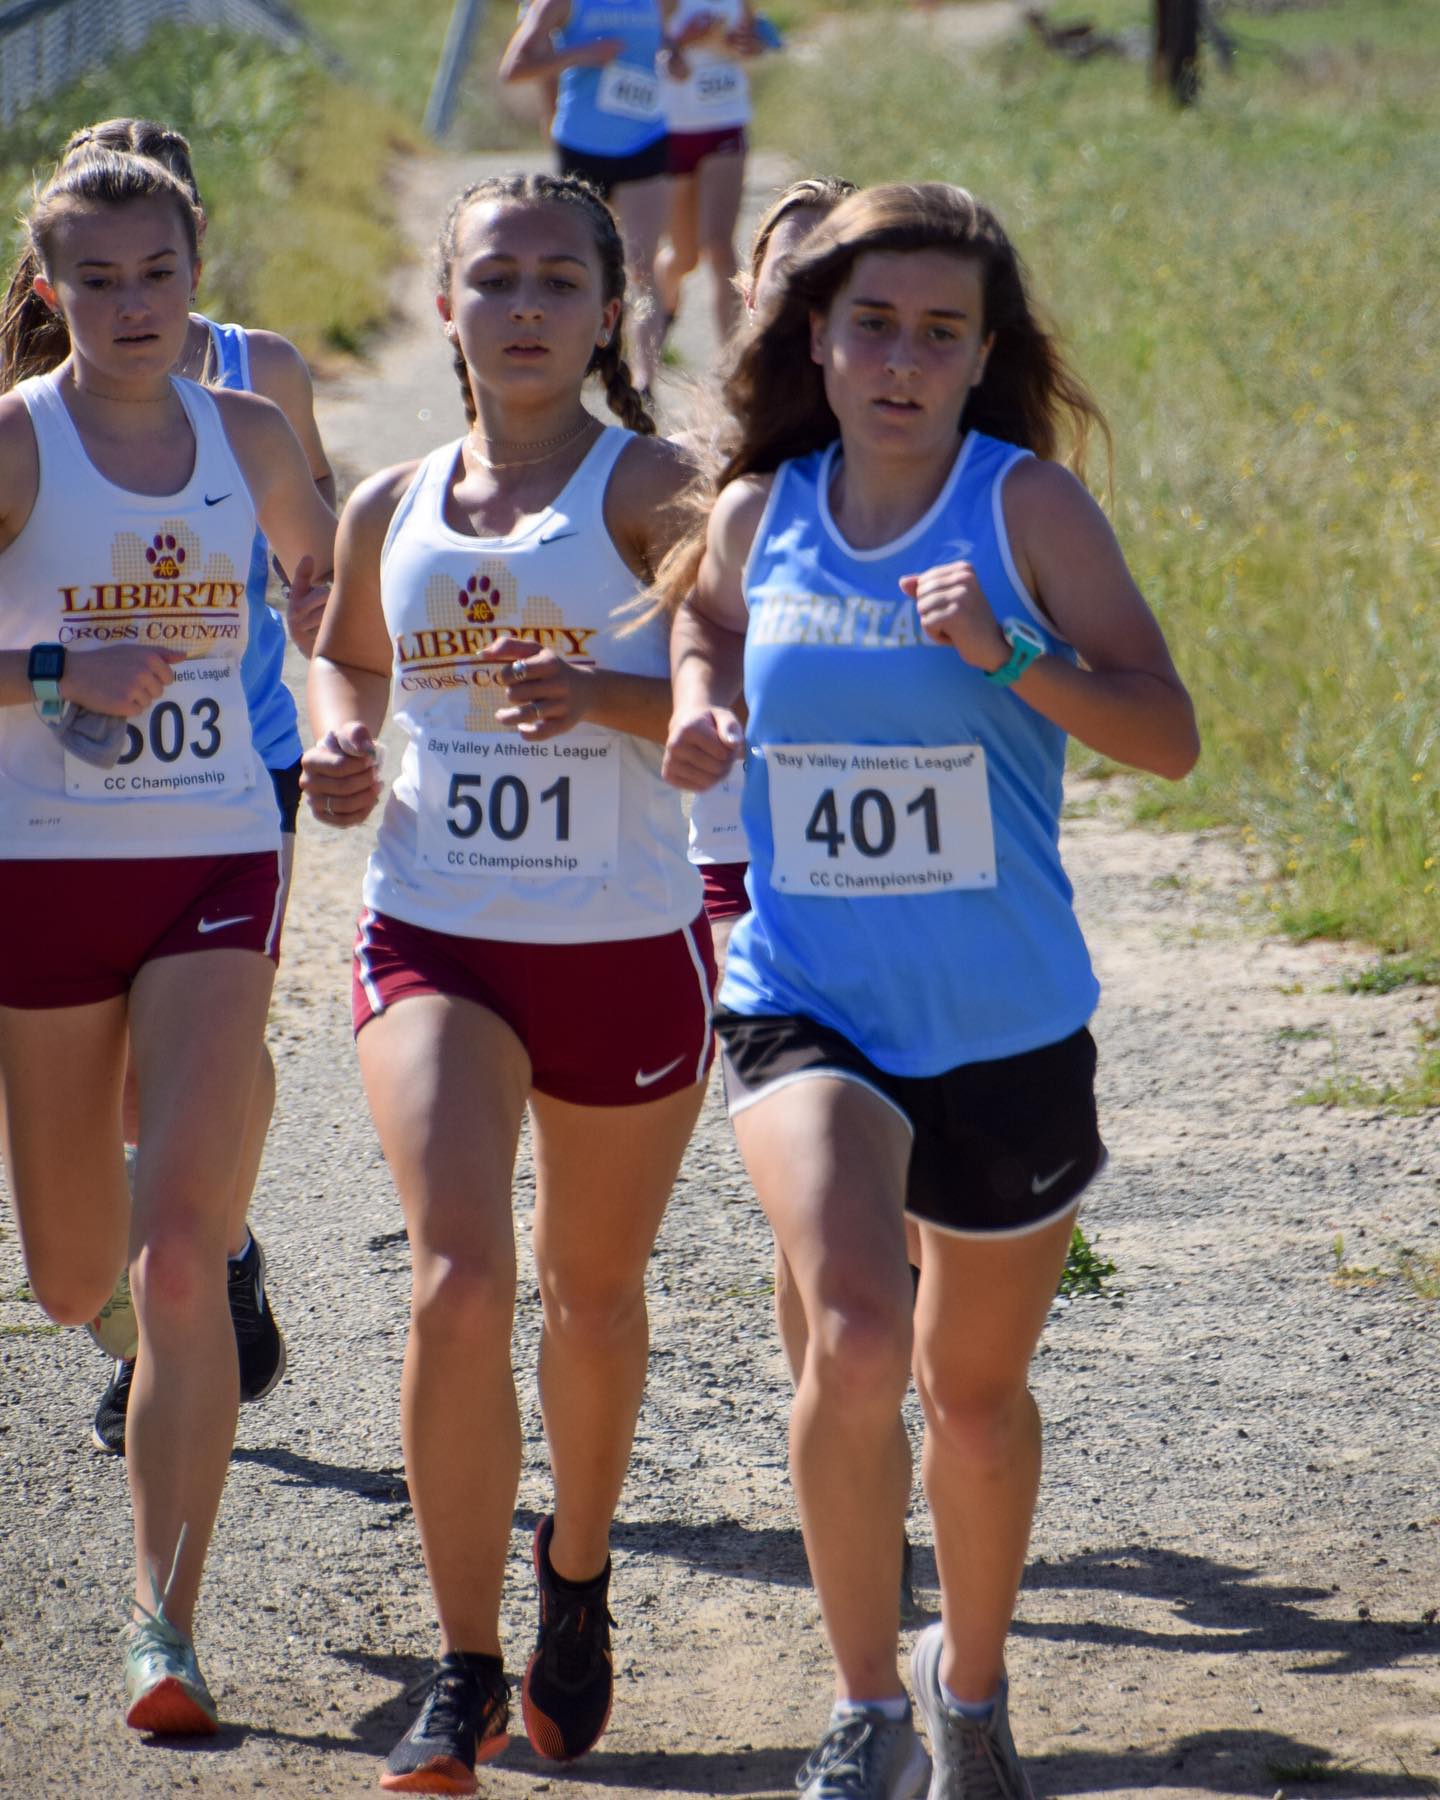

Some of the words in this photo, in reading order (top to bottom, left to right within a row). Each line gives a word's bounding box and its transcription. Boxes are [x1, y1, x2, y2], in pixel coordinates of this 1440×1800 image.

[58, 582, 245, 612] LIBERTY
[752, 593, 940, 646] HERITA
[58, 625, 139, 643] CROSS
[146, 621, 241, 639] COUNTRY
[198, 667, 230, 682] League
[400, 673, 467, 692] CROSS
[428, 739, 449, 756] Bay
[452, 740, 490, 757] Valley
[494, 743, 548, 757] Athletic
[554, 744, 607, 760] League
[777, 752, 803, 770] Bay
[807, 753, 847, 771] Valley
[852, 755, 910, 770] Athletic
[915, 755, 971, 771] League
[104, 777, 126, 790] CC
[131, 770, 225, 790] Championship
[447, 774, 570, 841] 501
[806, 787, 940, 858] 401
[447, 851, 464, 865] CC
[469, 853, 577, 871] Championship
[810, 872, 830, 887] CC
[835, 870, 953, 889] Championship
